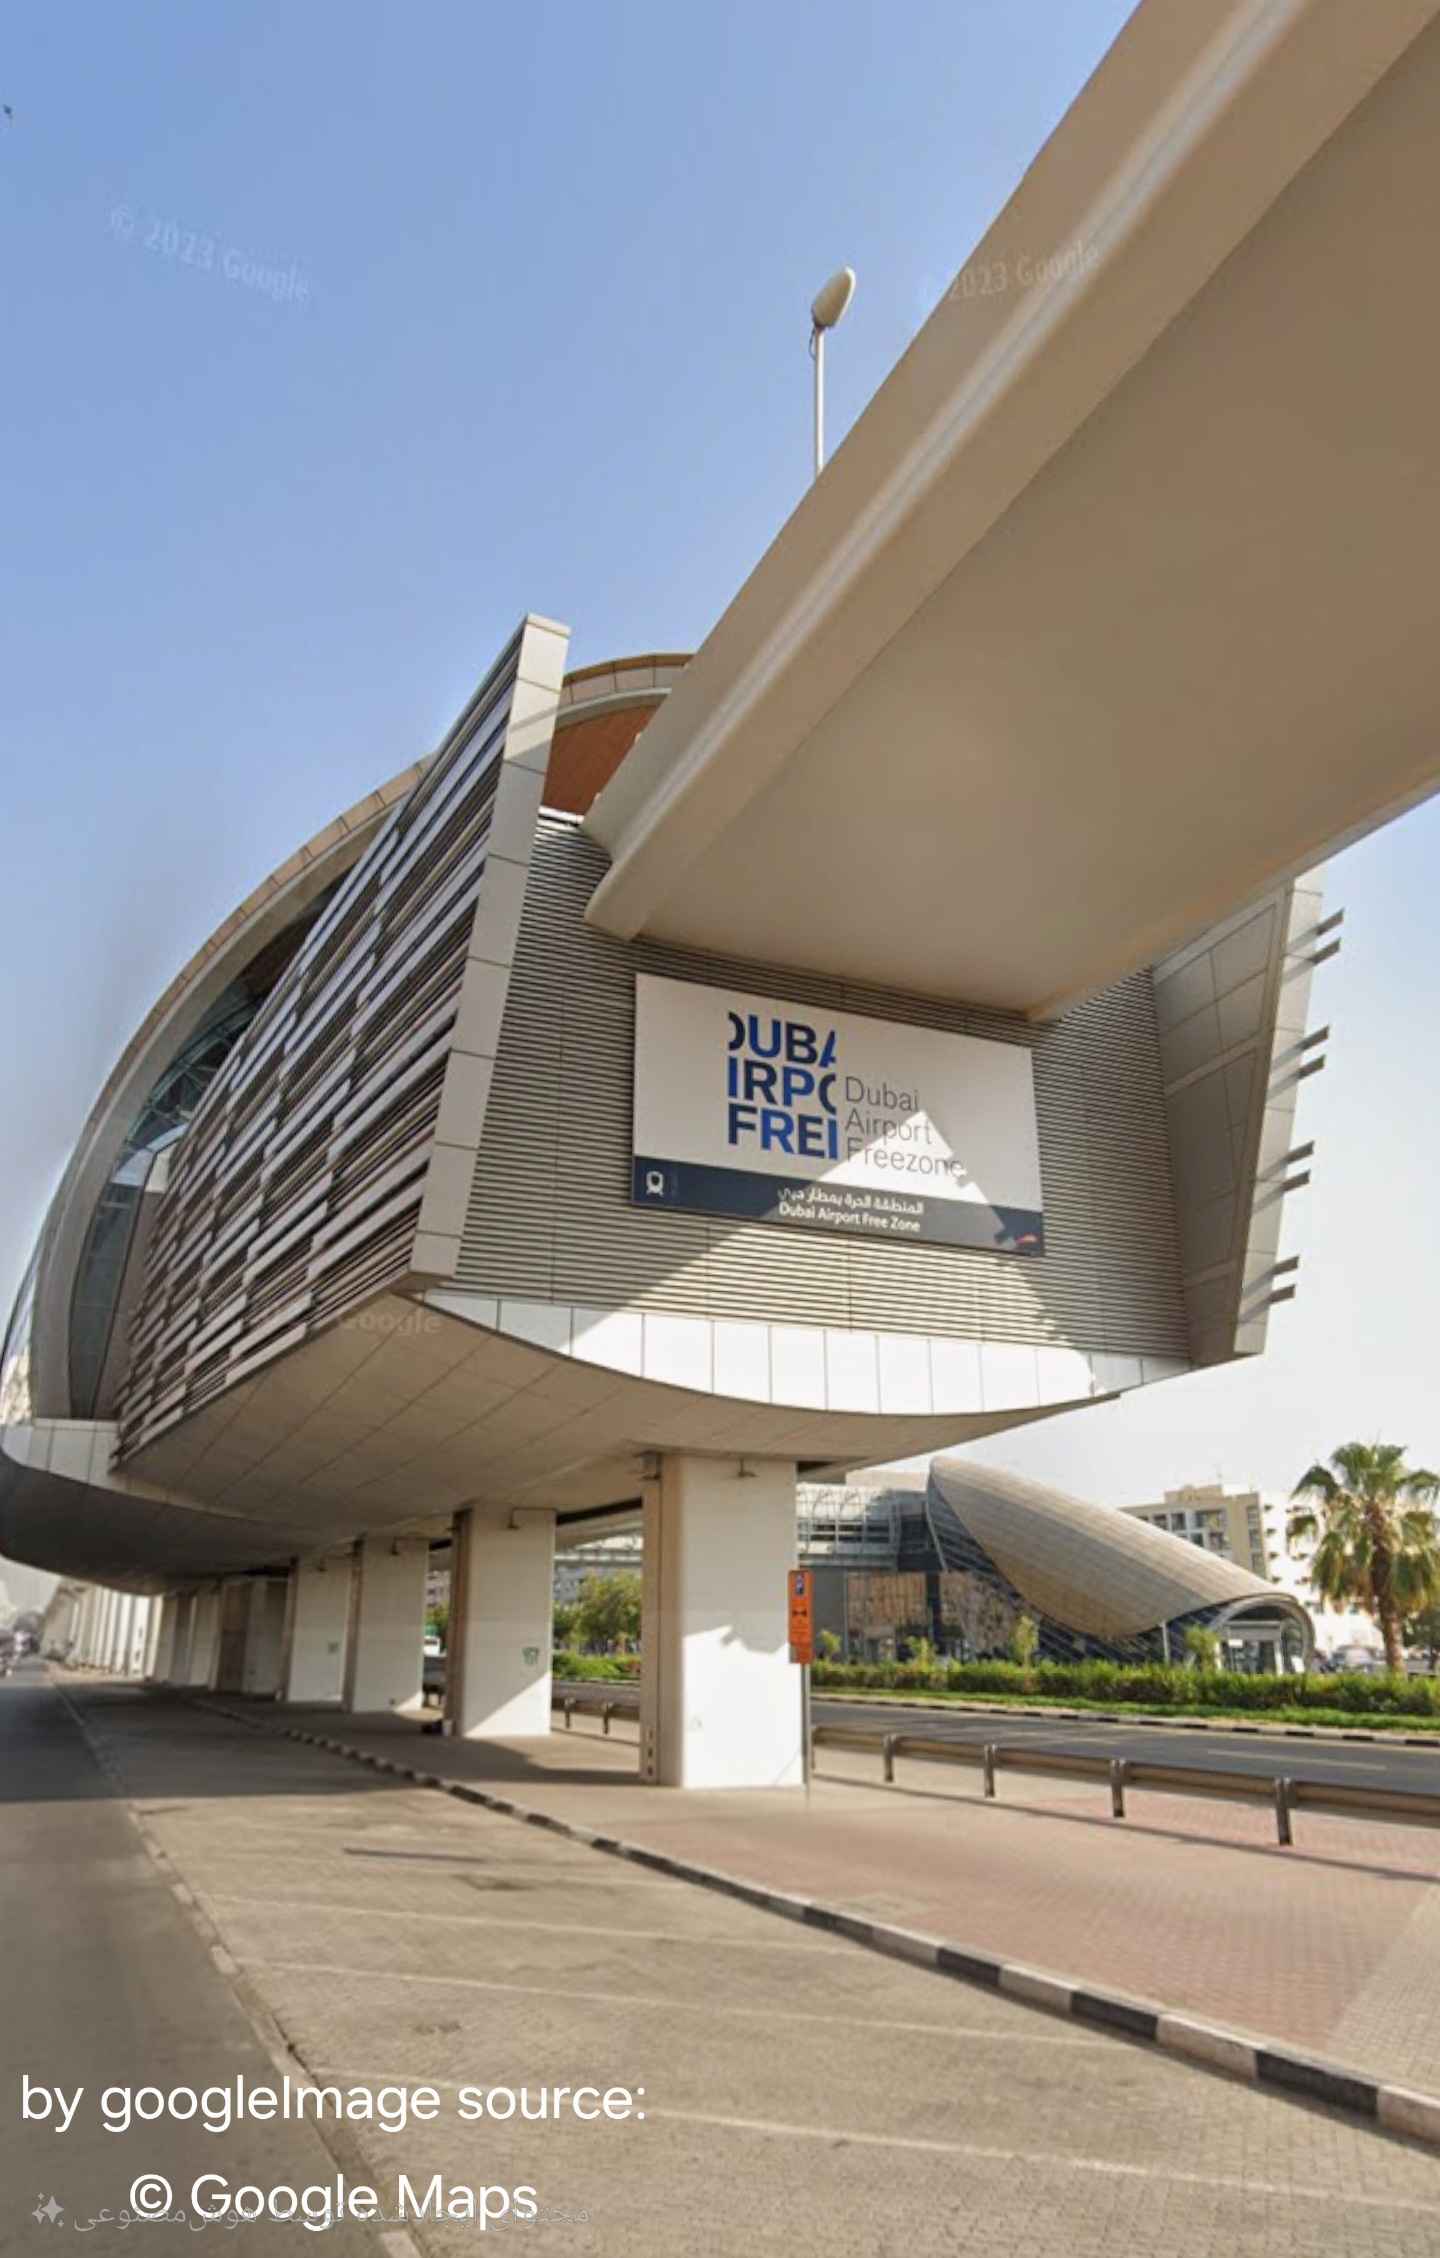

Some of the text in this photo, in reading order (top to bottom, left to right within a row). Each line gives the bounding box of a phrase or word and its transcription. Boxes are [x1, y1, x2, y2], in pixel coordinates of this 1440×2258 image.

[845, 1075, 919, 1112] Dubai
[845, 1107, 933, 1145] Airport
[847, 1136, 967, 1179] Freezone
[778, 1200, 921, 1232] Dubai Airport Free Zone
